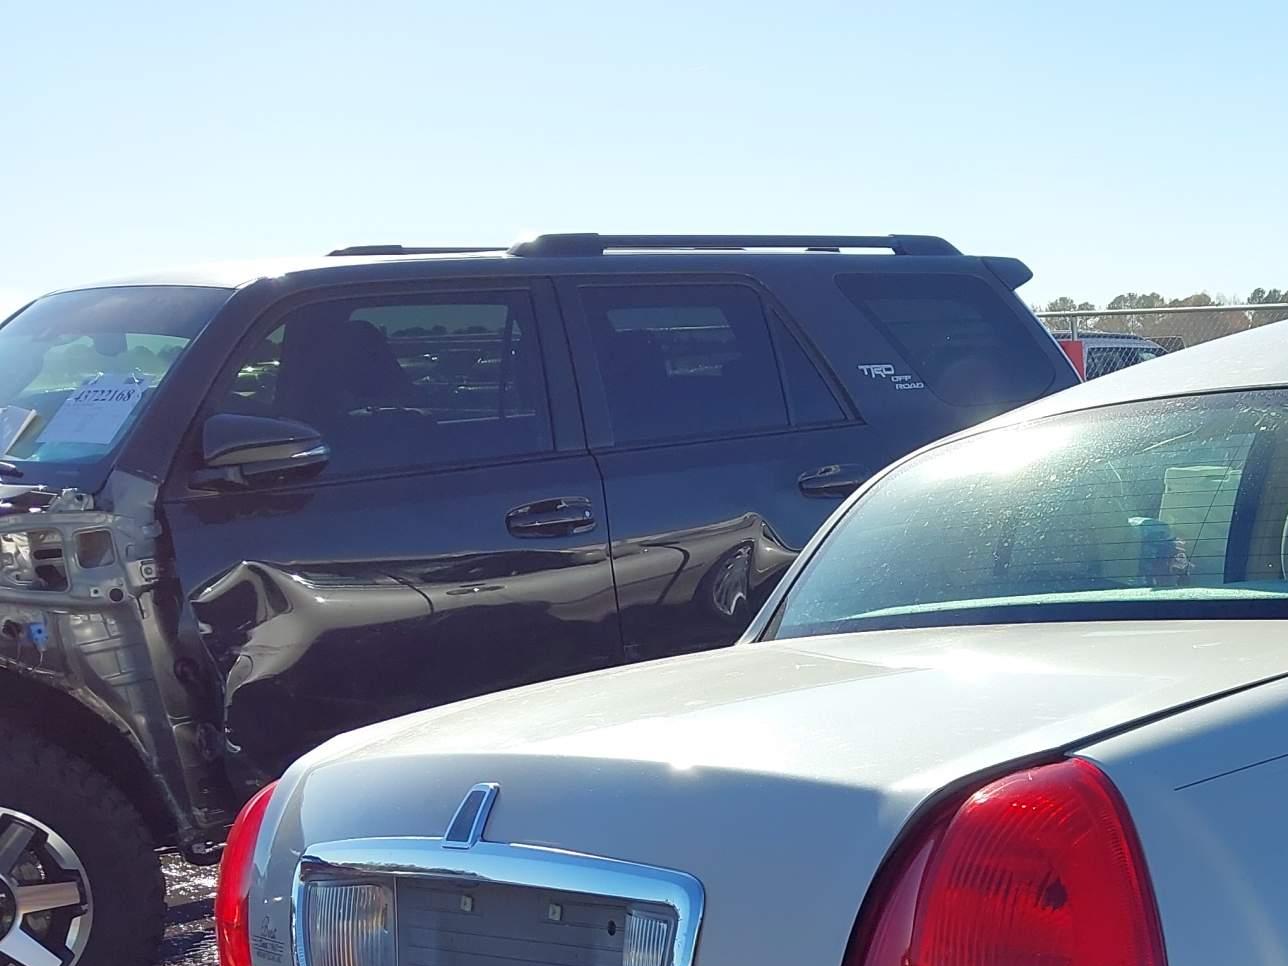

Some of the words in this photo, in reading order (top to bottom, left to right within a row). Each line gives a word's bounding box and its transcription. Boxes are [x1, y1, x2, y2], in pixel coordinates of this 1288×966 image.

[858, 364, 895, 379] TRD
[895, 382, 924, 390] ROAD
[73, 388, 136, 402] 43722168
